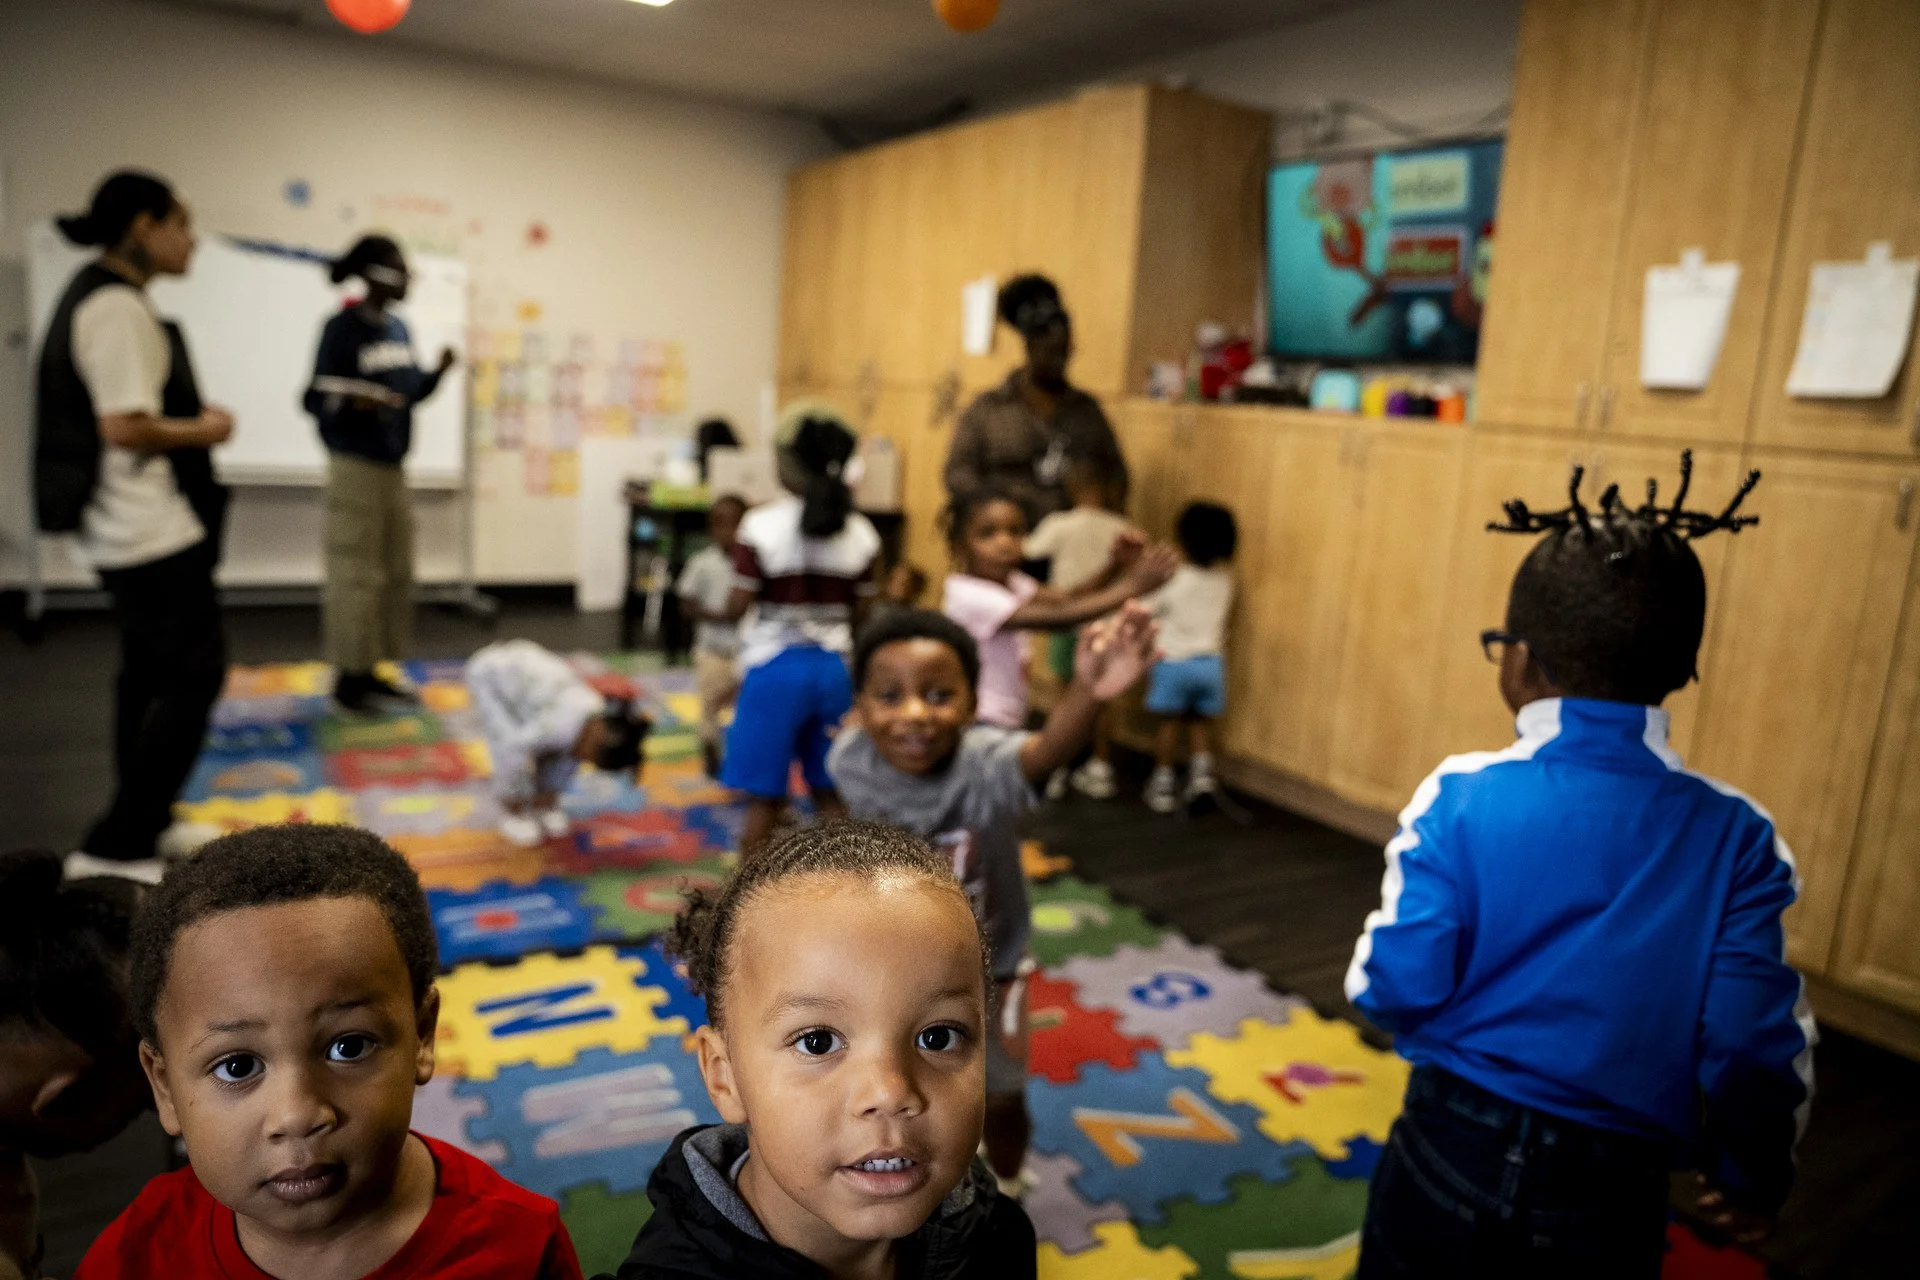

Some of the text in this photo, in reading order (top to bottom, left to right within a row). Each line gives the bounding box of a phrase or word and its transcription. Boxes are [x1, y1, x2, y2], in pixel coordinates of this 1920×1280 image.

[475, 980, 618, 1038] N
[1129, 969, 1213, 1010] 8
[1071, 1085, 1241, 1168] Z
